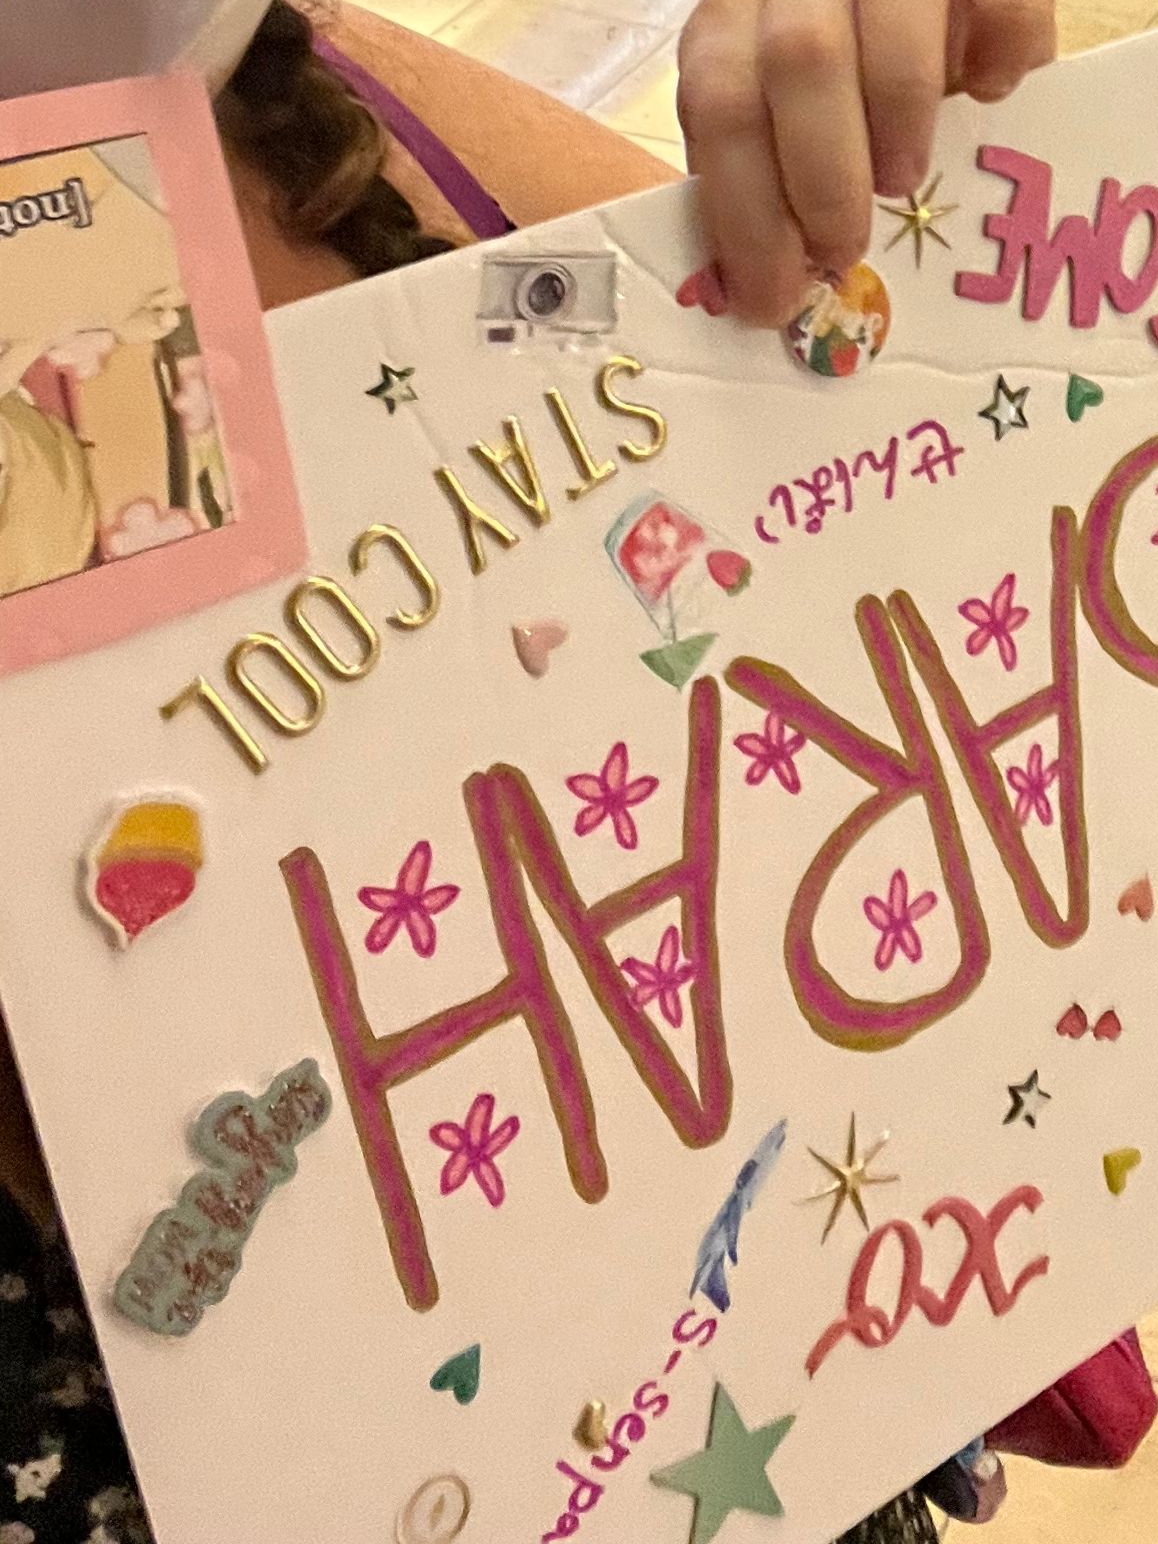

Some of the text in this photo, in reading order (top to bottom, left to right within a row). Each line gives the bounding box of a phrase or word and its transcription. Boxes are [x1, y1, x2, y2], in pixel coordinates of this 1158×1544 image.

[159, 355, 668, 776] STAY COOL
[754, 420, 966, 545] せんぱい
